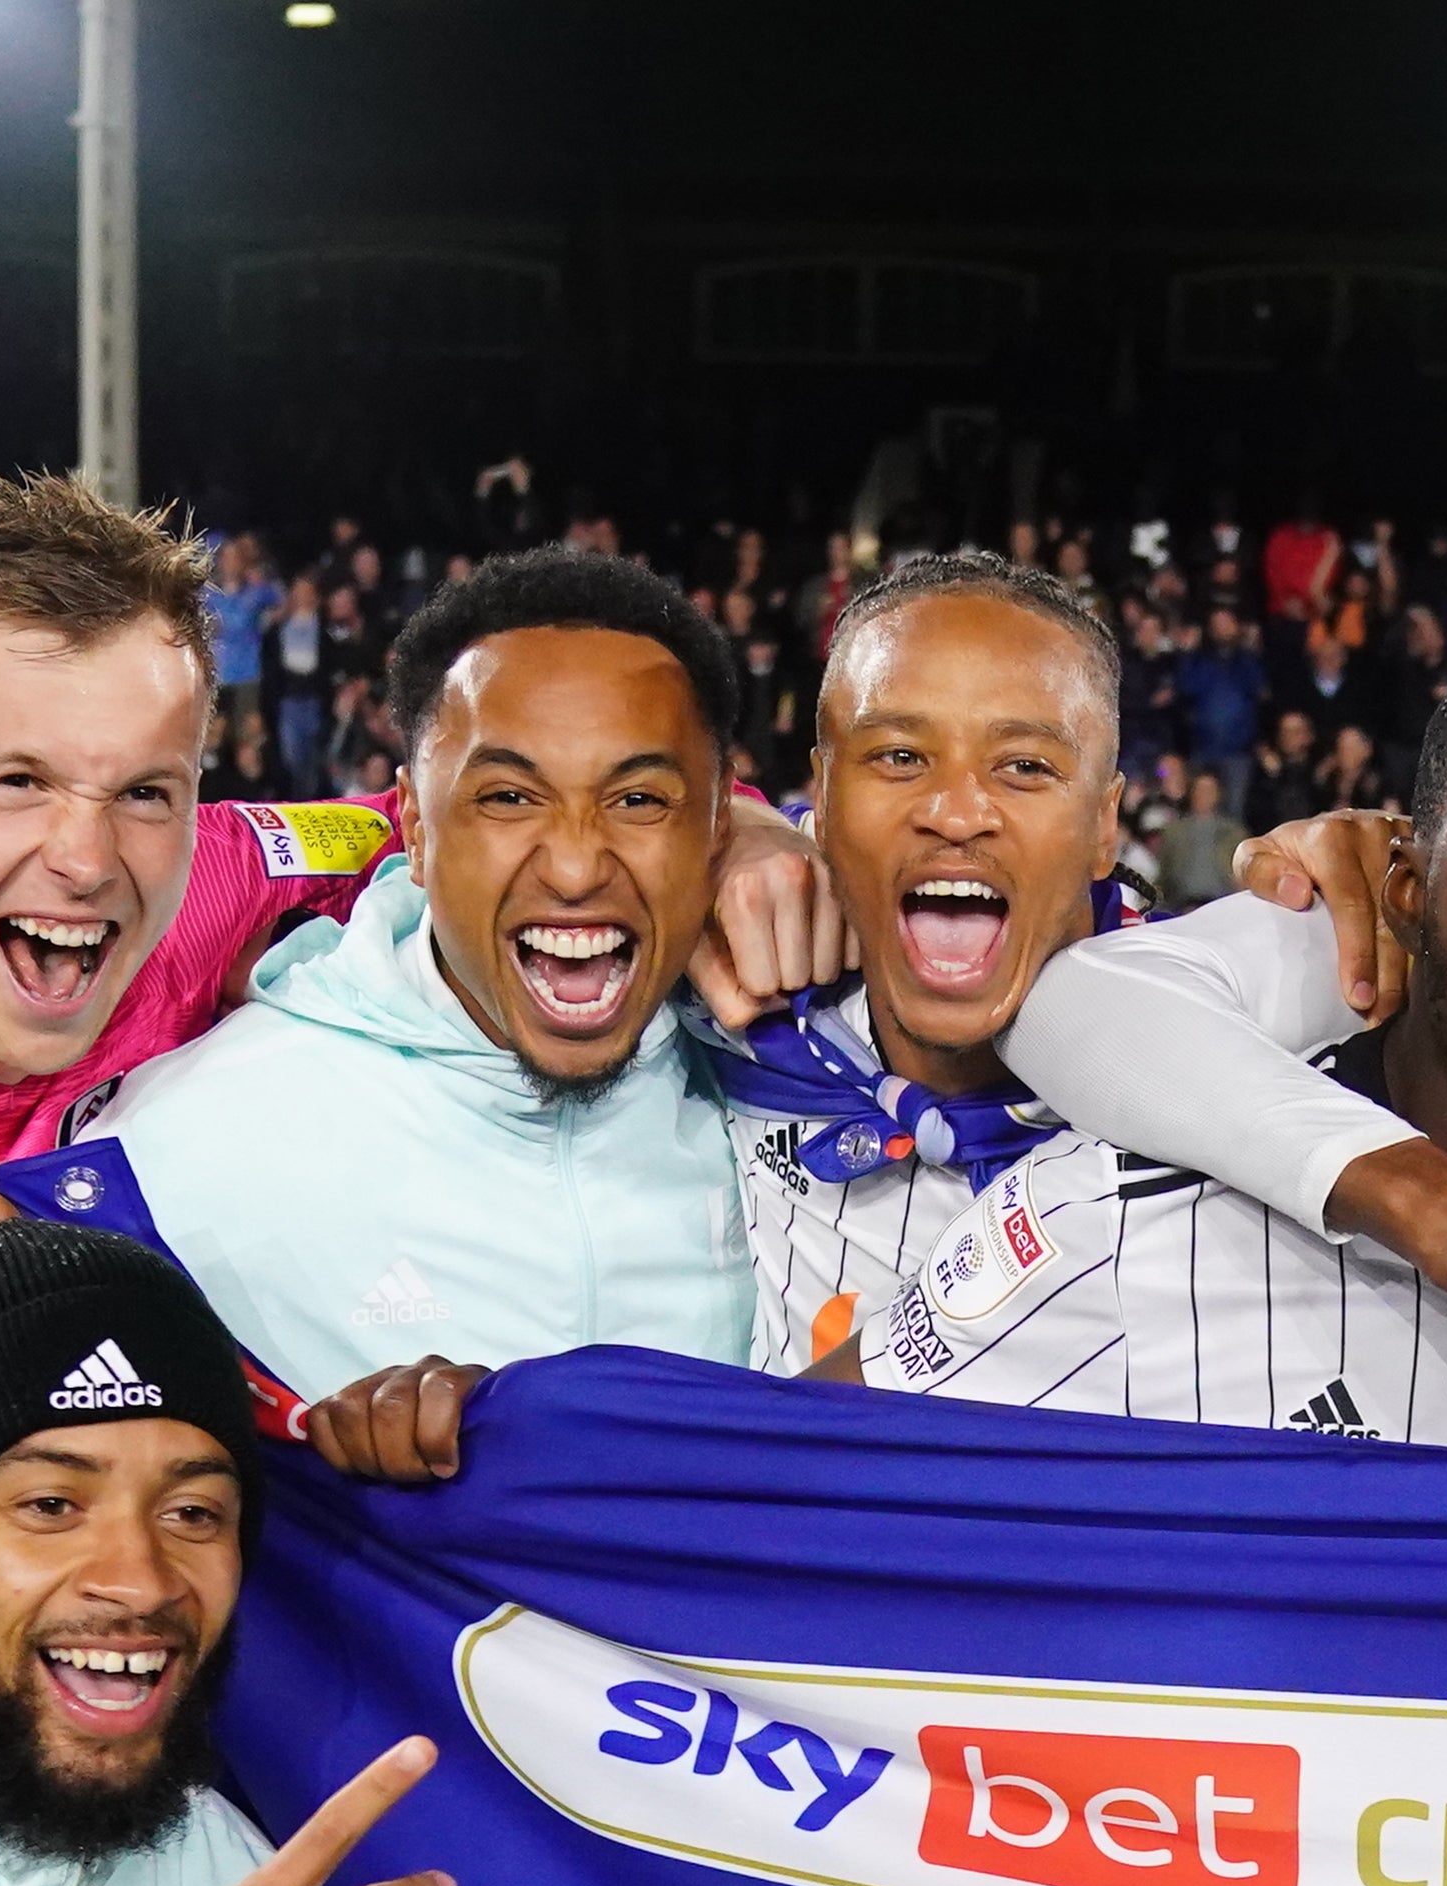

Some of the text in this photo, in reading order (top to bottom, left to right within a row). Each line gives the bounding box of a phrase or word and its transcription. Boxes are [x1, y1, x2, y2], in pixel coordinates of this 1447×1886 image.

[270, 832, 294, 867] sky
[755, 1141, 810, 1197] adidas
[983, 1190, 1020, 1279] CHAMPIONSHIP
[1001, 1174, 1039, 1262] sky bet
[935, 1259, 955, 1299] EFL
[352, 1299, 452, 1326] adidas
[903, 1286, 952, 1368] TODAY
[894, 1336, 929, 1381] DAY
[49, 1382, 163, 1410] adidas
[598, 1680, 895, 1832] sky
[963, 1745, 1259, 1879] bet
